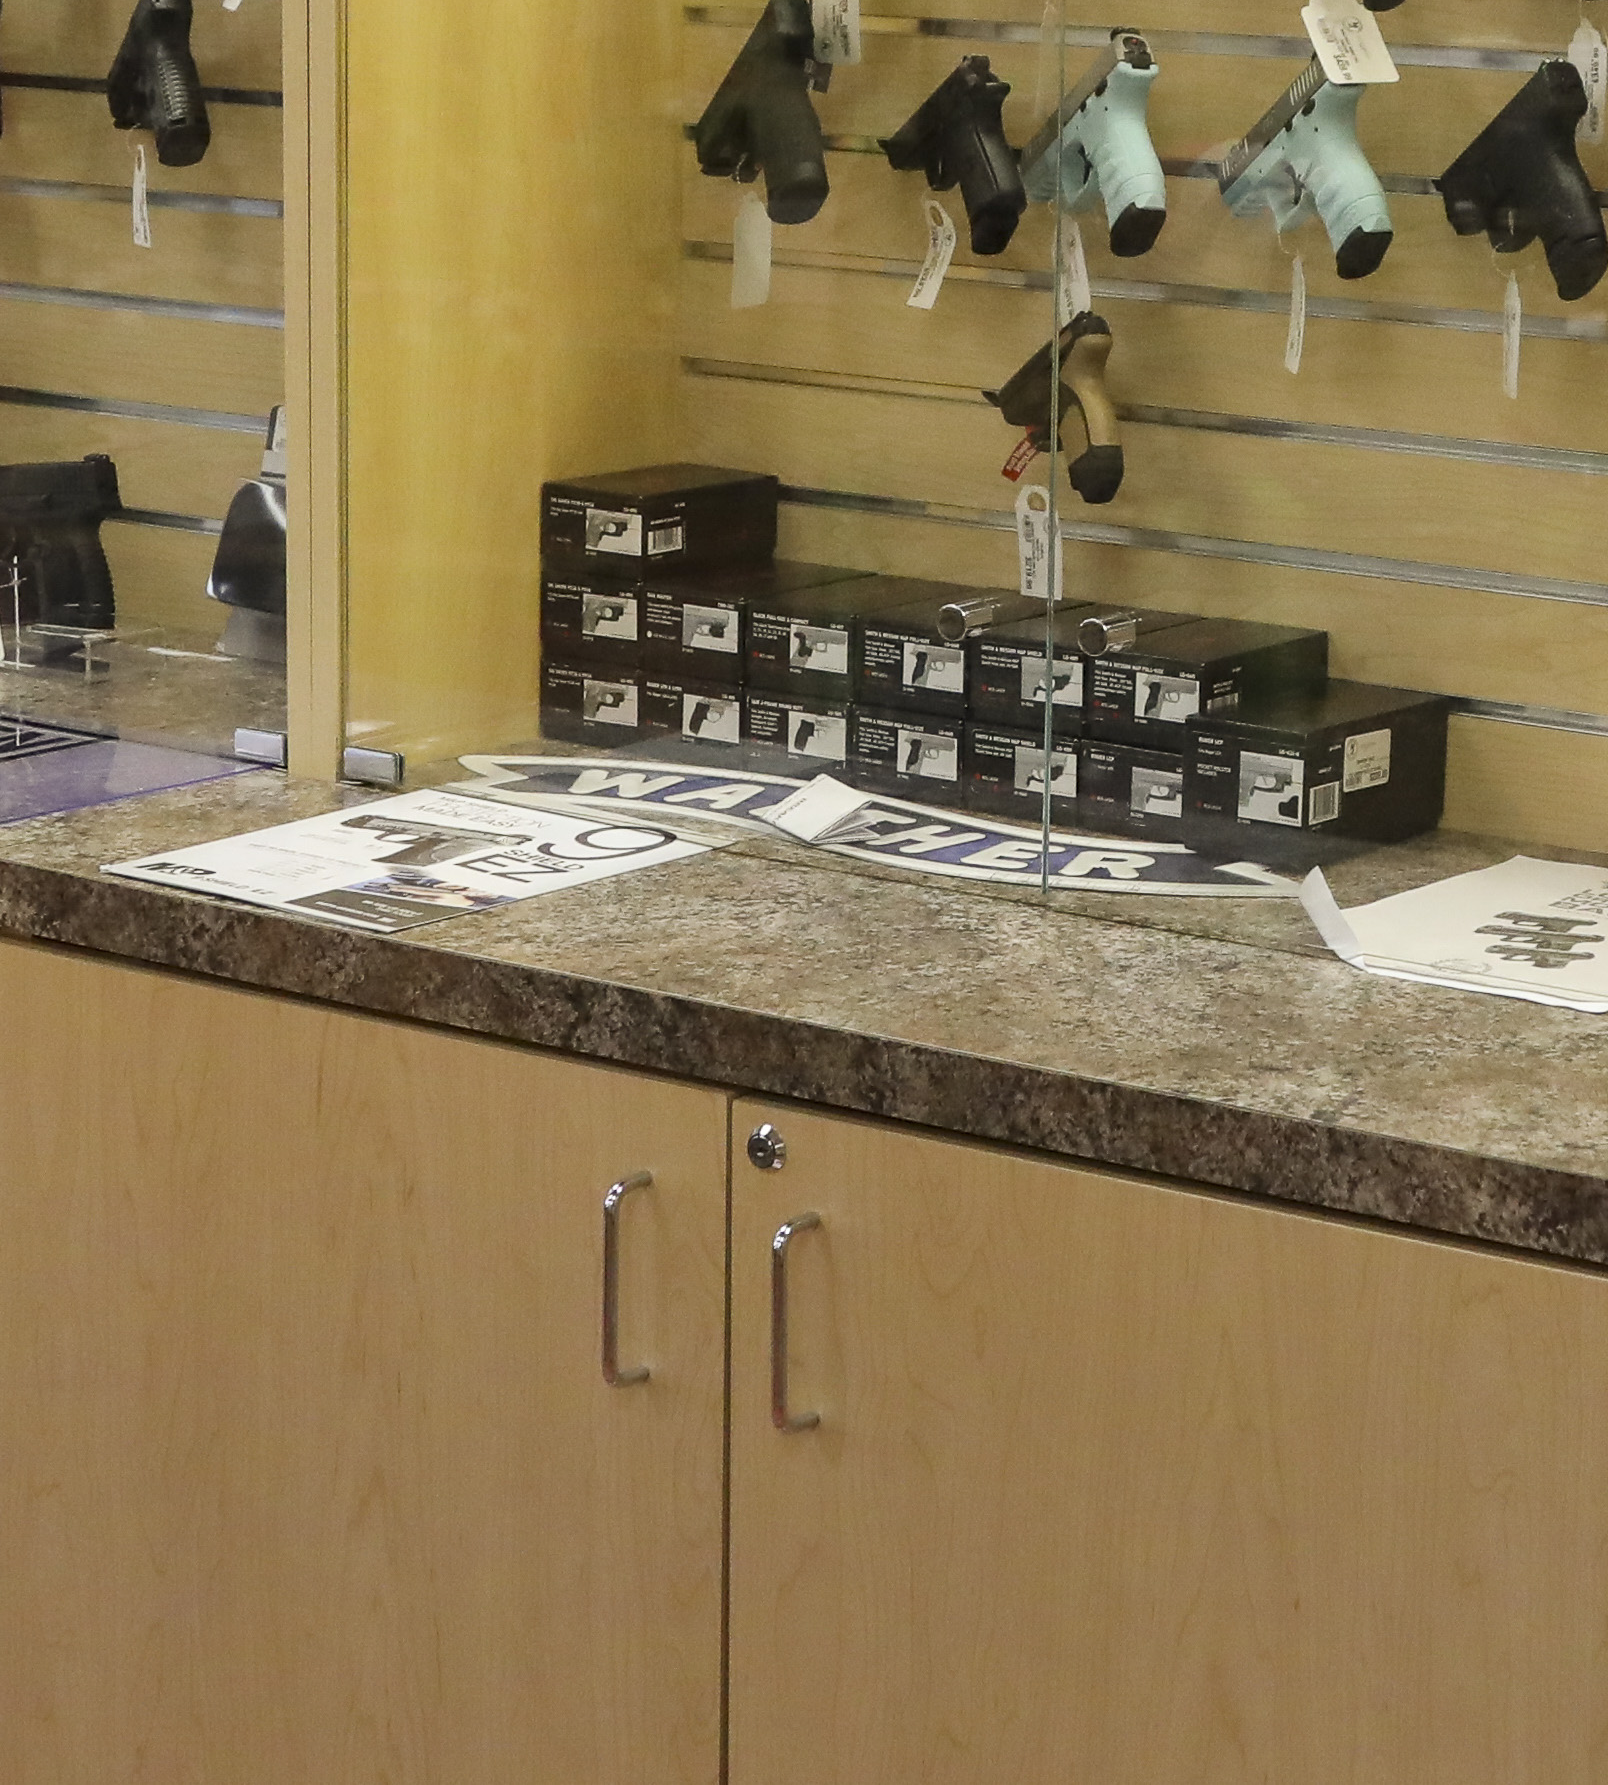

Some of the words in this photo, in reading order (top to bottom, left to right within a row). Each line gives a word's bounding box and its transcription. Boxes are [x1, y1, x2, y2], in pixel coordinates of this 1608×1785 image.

[568, 769, 1156, 879] WAHER
[455, 856, 568, 883] EZ
[503, 848, 584, 872] SHIELD
